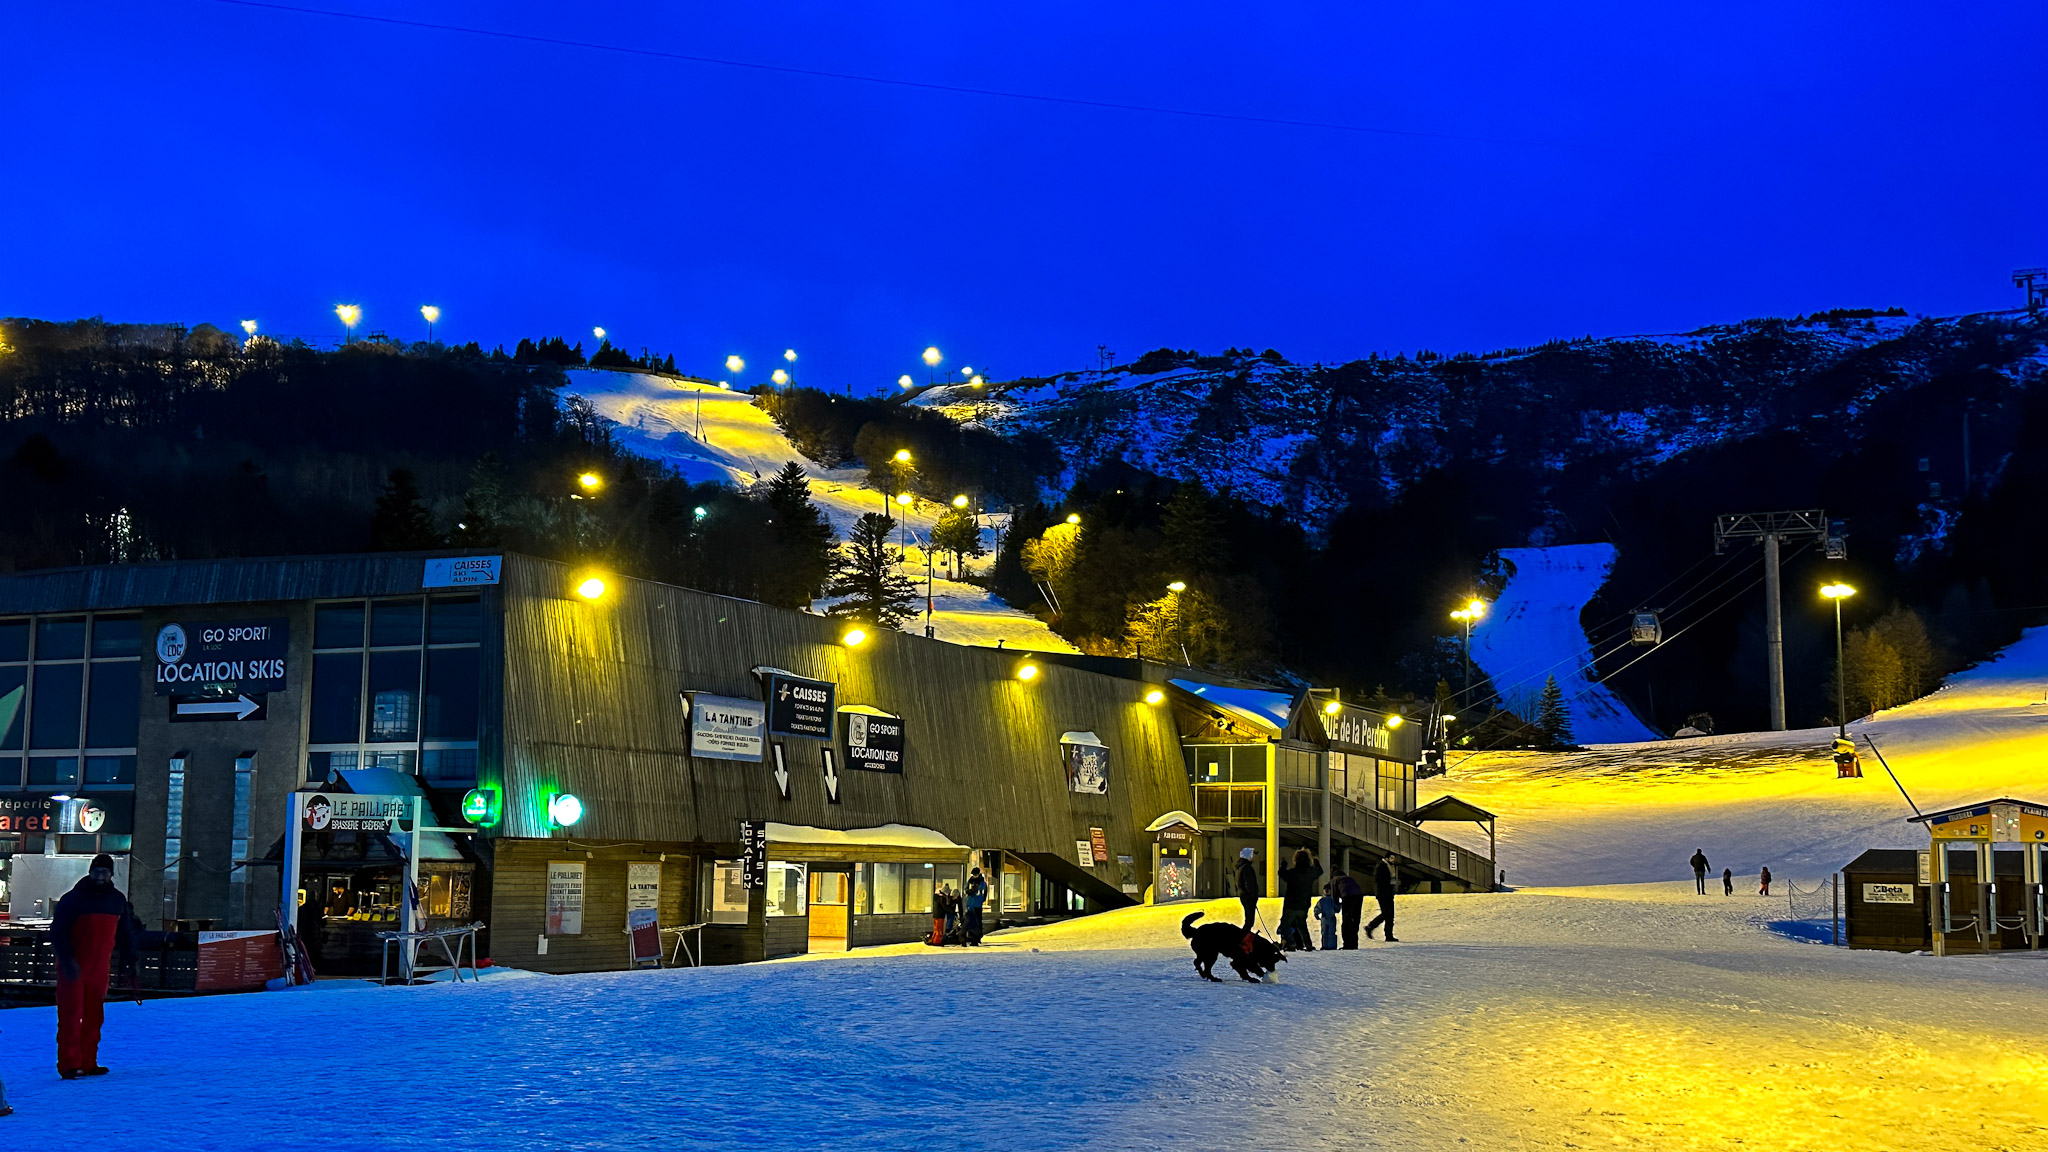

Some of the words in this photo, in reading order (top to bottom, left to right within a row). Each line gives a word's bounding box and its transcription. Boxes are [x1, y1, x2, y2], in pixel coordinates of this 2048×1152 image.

[454, 560, 492, 570] CAISSES
[203, 629, 225, 642] GO
[227, 626, 267, 642] SPORT
[156, 660, 244, 682] LOCATION
[248, 658, 285, 679] SKIS
[793, 686, 827, 703] CAISSES
[705, 711, 717, 723] LA
[719, 713, 753, 727] TANTINE
[869, 722, 880, 734] GO
[1340, 714, 1351, 743] de
[1351, 717, 1360, 745] la
[1361, 718, 1389, 750] Perdrix
[851, 746, 885, 761] LOCATION
[885, 750, 899, 762] SKIS
[333, 800, 348, 816] LE
[351, 800, 413, 818] PAILLARET
[331, 819, 359, 831] BRASSERIE
[743, 820, 754, 889] LOCATION
[756, 829, 766, 870] SKIS
